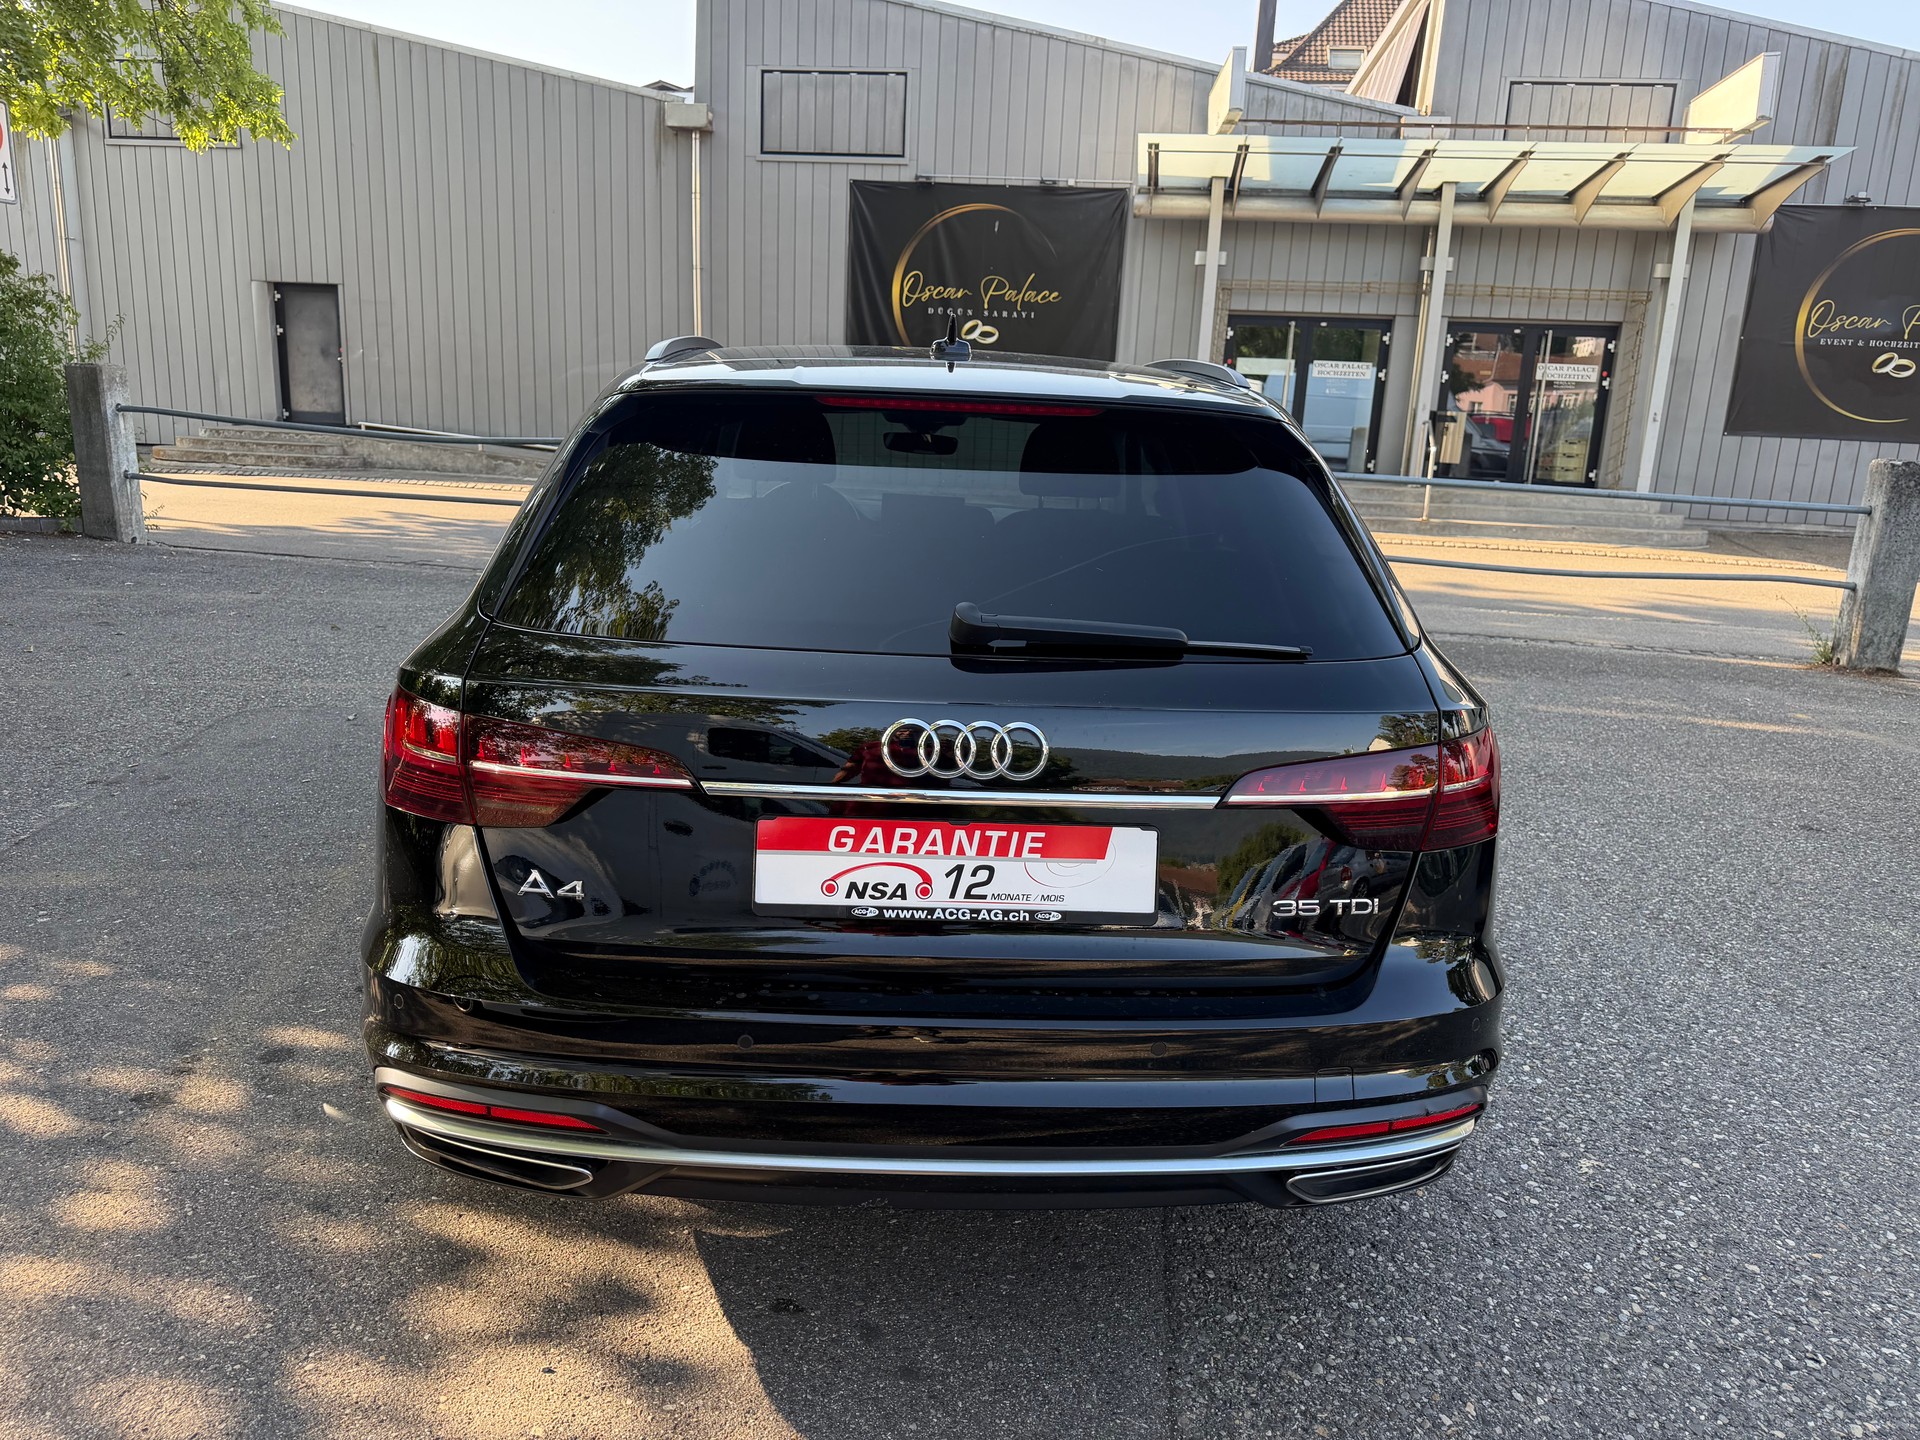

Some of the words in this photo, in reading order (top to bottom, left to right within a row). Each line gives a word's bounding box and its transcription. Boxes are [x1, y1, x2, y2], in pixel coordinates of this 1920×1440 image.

[903, 271, 972, 307] Oscar
[980, 273, 1062, 311] Palace
[1807, 300, 1892, 338] Oscar
[1820, 338, 1854, 346] EVENT
[1857, 339, 1865, 347] &
[828, 825, 1046, 858] GARANTIE
[517, 869, 584, 900] A4
[845, 881, 908, 900] NSA
[944, 863, 996, 900] 12
[990, 892, 1032, 902] MONATE
[1040, 893, 1065, 902] MOIS
[883, 908, 1030, 921] www.ACG-AG.ch
[1272, 899, 1320, 917] 35
[1329, 898, 1379, 916] TDI
